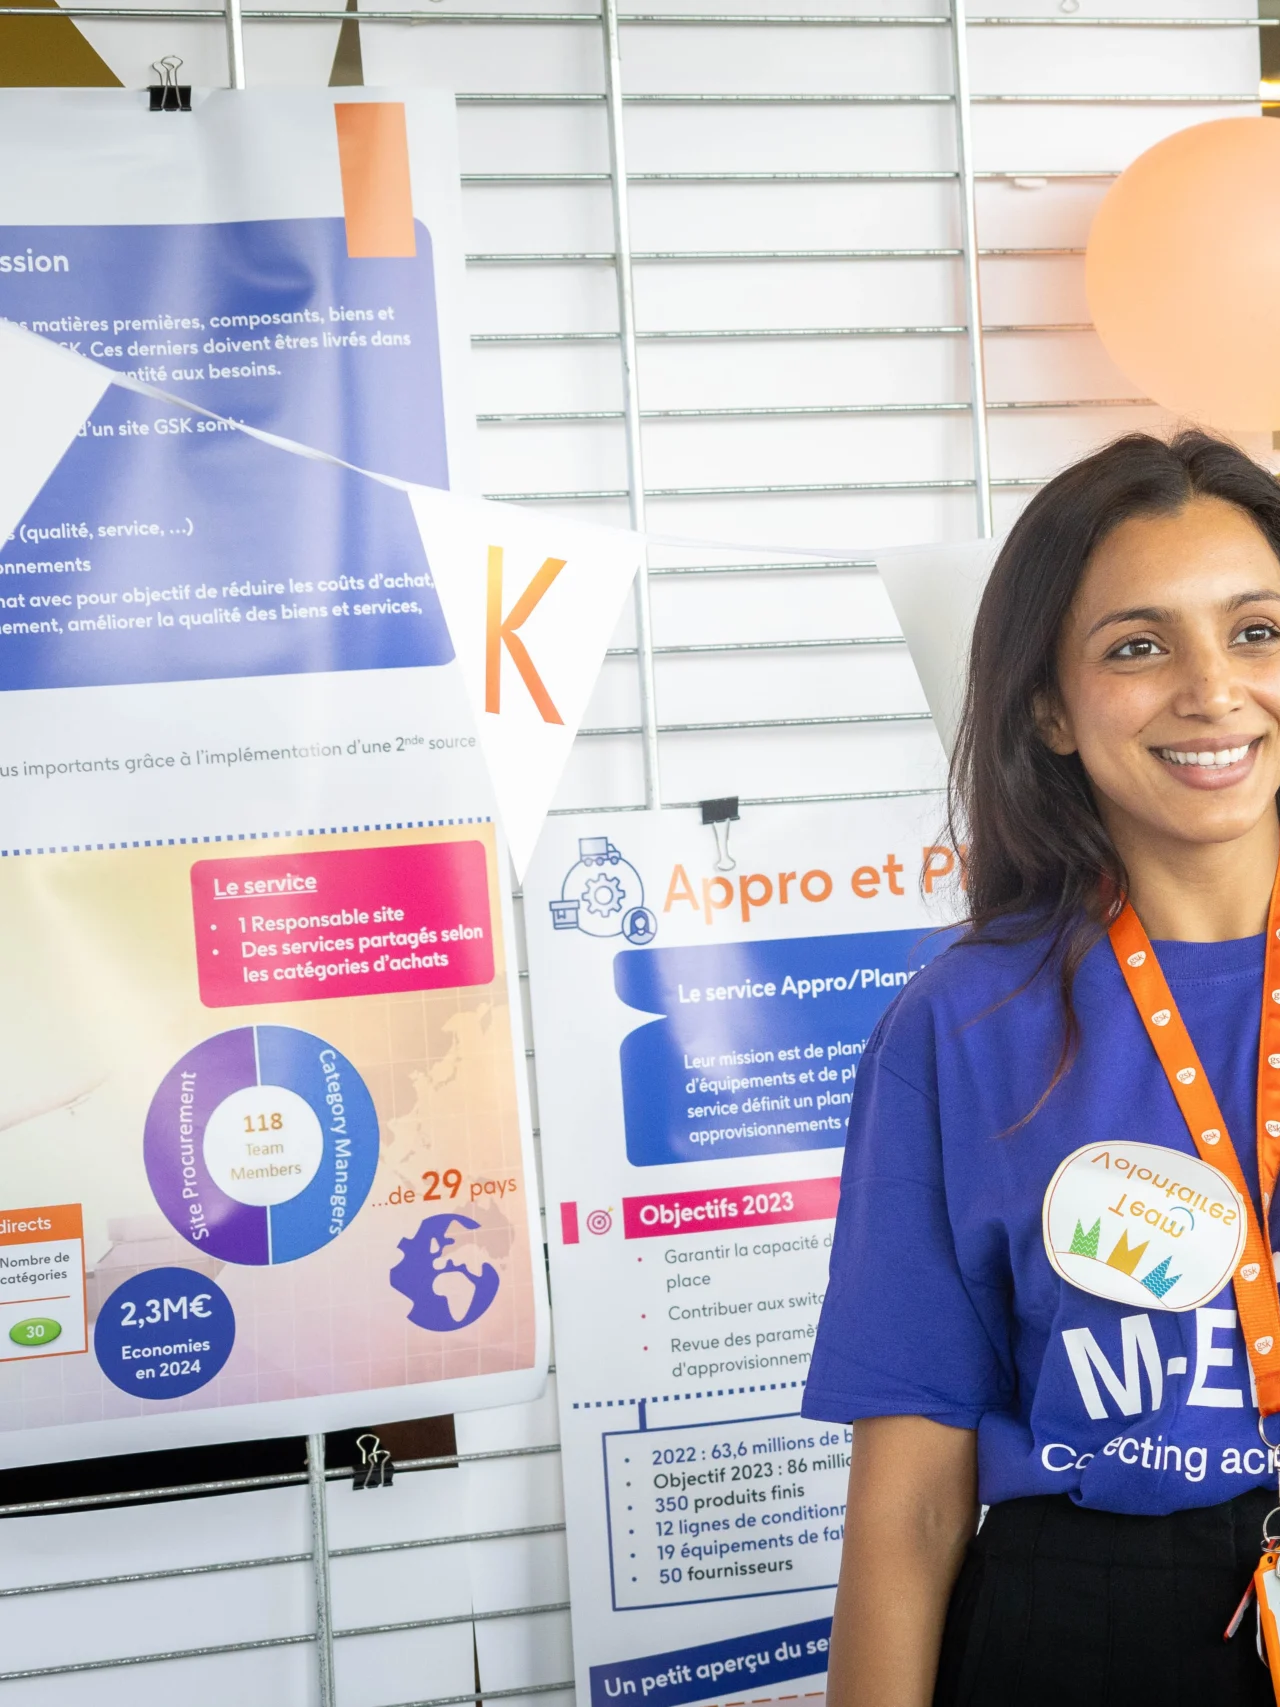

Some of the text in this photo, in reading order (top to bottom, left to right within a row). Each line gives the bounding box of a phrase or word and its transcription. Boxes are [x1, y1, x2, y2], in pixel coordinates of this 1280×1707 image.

[33, 315, 109, 333] matières
[113, 314, 205, 335] premières,
[209, 309, 325, 331] composants,
[329, 306, 374, 322] biens
[378, 307, 395, 321] et
[90, 331, 412, 357] Ces derniers doivent êtres livrés dans
[171, 369, 205, 381] aux
[208, 361, 282, 379] besoins.
[118, 420, 150, 436] site
[153, 417, 192, 435] GSK
[19, 522, 94, 544] (qualité,
[98, 520, 165, 537] service,
[29, 597, 73, 608] avec
[76, 592, 118, 610] pour
[122, 584, 191, 606] objectif
[195, 583, 218, 599] de
[222, 579, 285, 597] réduire
[289, 578, 314, 593] les
[317, 574, 365, 592] coûts
[67, 613, 153, 632] améliorer
[157, 611, 174, 627] la
[178, 607, 242, 630] qualité
[245, 606, 277, 622] des
[281, 603, 328, 620] biens
[332, 602, 350, 617] et
[353, 598, 423, 615] services,
[485, 544, 568, 725] K
[23, 756, 120, 779] importants
[125, 753, 175, 775] grâce
[180, 751, 192, 766] à
[196, 741, 343, 767] l'implémentation
[346, 737, 392, 756] d'une
[428, 735, 477, 750] source
[213, 872, 317, 897] Le service
[662, 863, 833, 925] Appro
[850, 853, 905, 899] et
[238, 905, 405, 936] 1 Responsable site
[241, 923, 484, 959] Des services partagés selon
[243, 951, 449, 983] les catégories d'achats
[1129, 954, 1145, 966] gsk
[678, 984, 700, 1003] Le
[705, 978, 777, 1002] service
[1153, 1012, 1169, 1024] gsk
[684, 1054, 715, 1070] Leur
[719, 1048, 775, 1067] mission
[778, 1046, 801, 1061] est
[803, 1043, 824, 1059] de
[685, 1070, 796, 1096] d'équipements
[799, 1069, 815, 1083] et
[818, 1066, 838, 1082] de
[1178, 1070, 1194, 1081] gsk
[687, 1101, 738, 1119] service
[742, 1093, 790, 1114] définit
[794, 1095, 813, 1108] un
[243, 1112, 284, 1133] 118
[689, 1113, 842, 1146] approvisionnements
[1267, 1123, 1280, 1133] gsk
[246, 1141, 285, 1157] Team
[319, 1048, 352, 1236] Category Managers
[1203, 1132, 1219, 1142] gsk
[179, 1070, 210, 1240] Site Procurement
[230, 1161, 303, 1181] Members
[420, 1168, 463, 1203] 29
[469, 1176, 518, 1202] pays
[639, 1191, 795, 1229] Objectifs 2023
[0, 1251, 70, 1269] Nombre de
[664, 1244, 731, 1265] Garantir
[734, 1242, 749, 1258] la
[752, 1233, 819, 1258] capacité
[0, 1268, 68, 1286] catégories
[666, 1272, 711, 1293] place
[1242, 1266, 1258, 1278] gsk
[119, 1293, 212, 1330] 2,3M€
[668, 1301, 753, 1322] Contribuer
[757, 1296, 785, 1310] aux
[26, 1324, 45, 1339] 30
[671, 1335, 719, 1353] Revue
[724, 1331, 751, 1348] des
[121, 1338, 211, 1361] Economies
[1256, 1339, 1271, 1351] gsk
[135, 1360, 201, 1380] en 2024
[651, 1446, 697, 1466] 2022
[711, 1442, 748, 1462] 63,6
[752, 1433, 815, 1455] millions
[819, 1431, 840, 1447] de
[653, 1468, 726, 1492] Objectif
[730, 1462, 775, 1482] 2023
[787, 1458, 808, 1475] 86
[655, 1483, 805, 1514] 350 produits finis
[656, 1521, 675, 1537] 12
[678, 1516, 730, 1538] lignes
[735, 1512, 757, 1529] de
[657, 1544, 675, 1560] 19
[680, 1534, 794, 1562] équipements
[798, 1528, 819, 1545] de
[659, 1558, 793, 1585] 50 fournisseurs
[604, 1675, 637, 1698] Un
[641, 1664, 692, 1696] petit
[695, 1650, 770, 1681] aperçu
[774, 1642, 802, 1661] du
